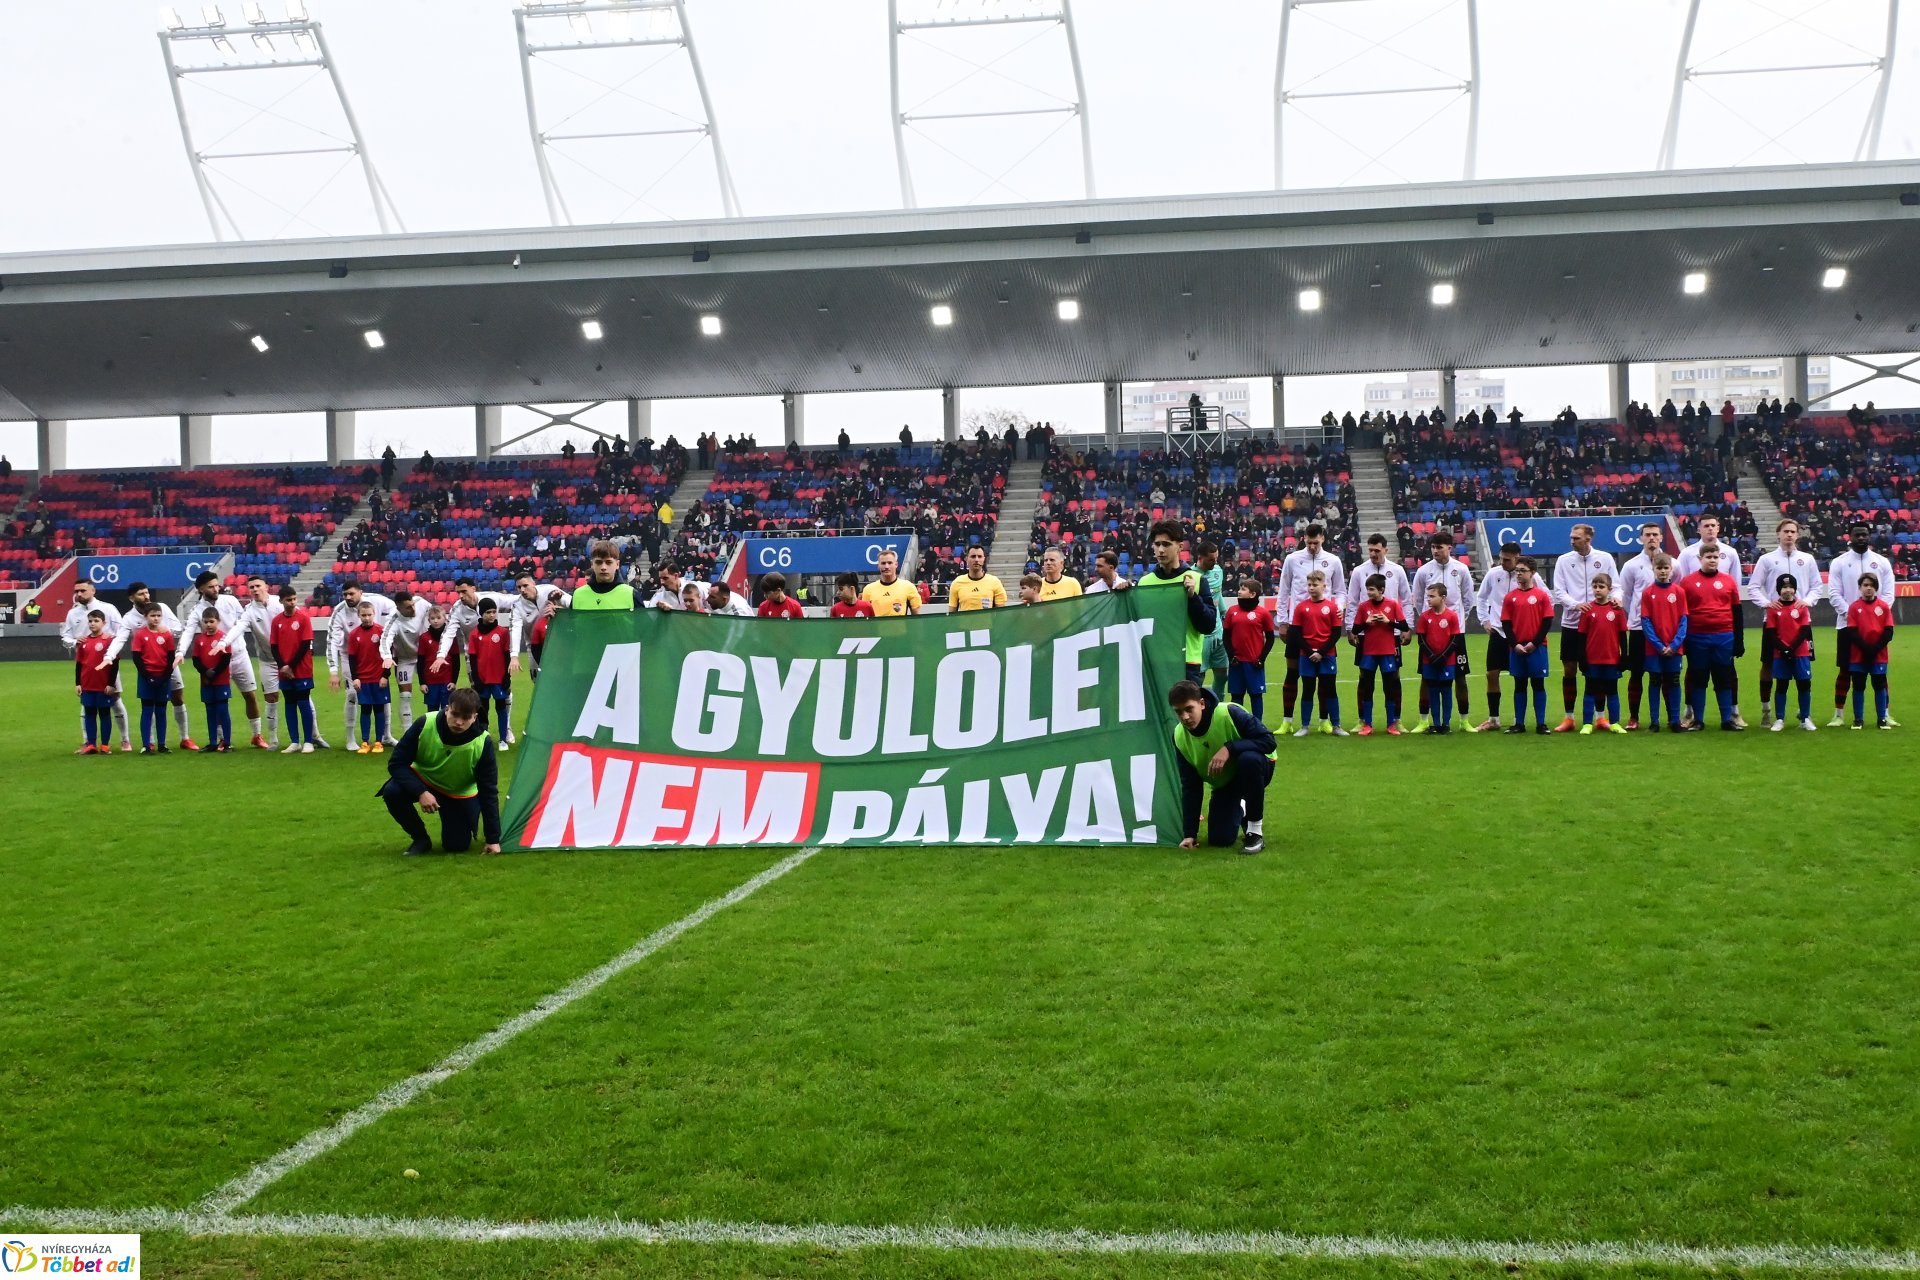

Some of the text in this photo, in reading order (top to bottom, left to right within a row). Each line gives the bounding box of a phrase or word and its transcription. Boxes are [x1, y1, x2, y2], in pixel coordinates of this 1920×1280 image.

[1497, 526, 1536, 548] C4
[759, 547, 792, 567] C6
[89, 564, 119, 584] C8
[572, 618, 1154, 756] A GYŰLÖLET
[530, 750, 1157, 848] NEM PÁLYA!
